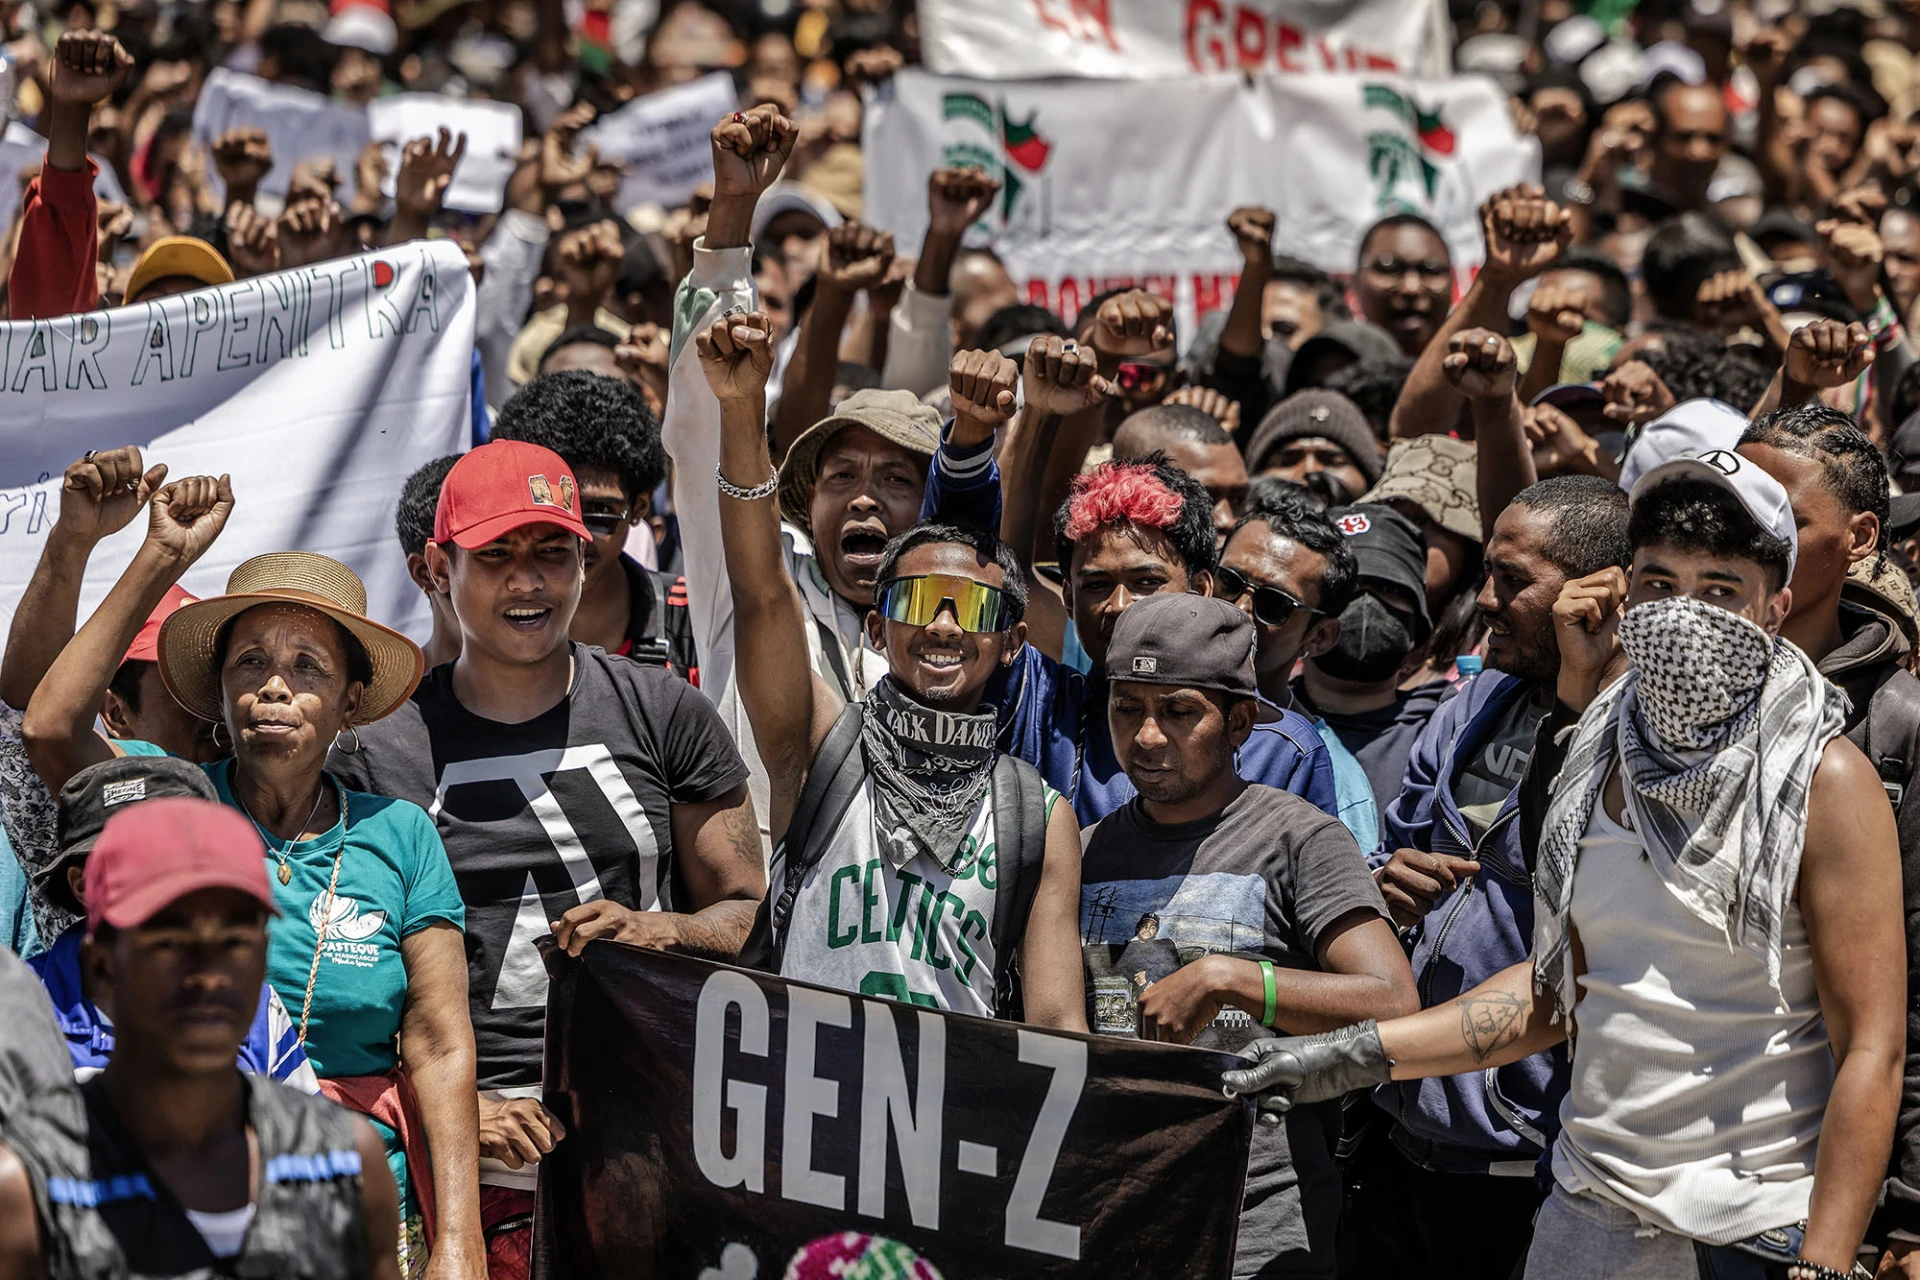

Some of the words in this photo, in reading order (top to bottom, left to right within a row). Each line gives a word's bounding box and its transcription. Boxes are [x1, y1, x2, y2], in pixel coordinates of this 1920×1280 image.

[131, 249, 440, 386] APENITRA
[321, 942, 380, 956] PASTEQUE
[692, 969, 1088, 1261] GEN-Z
